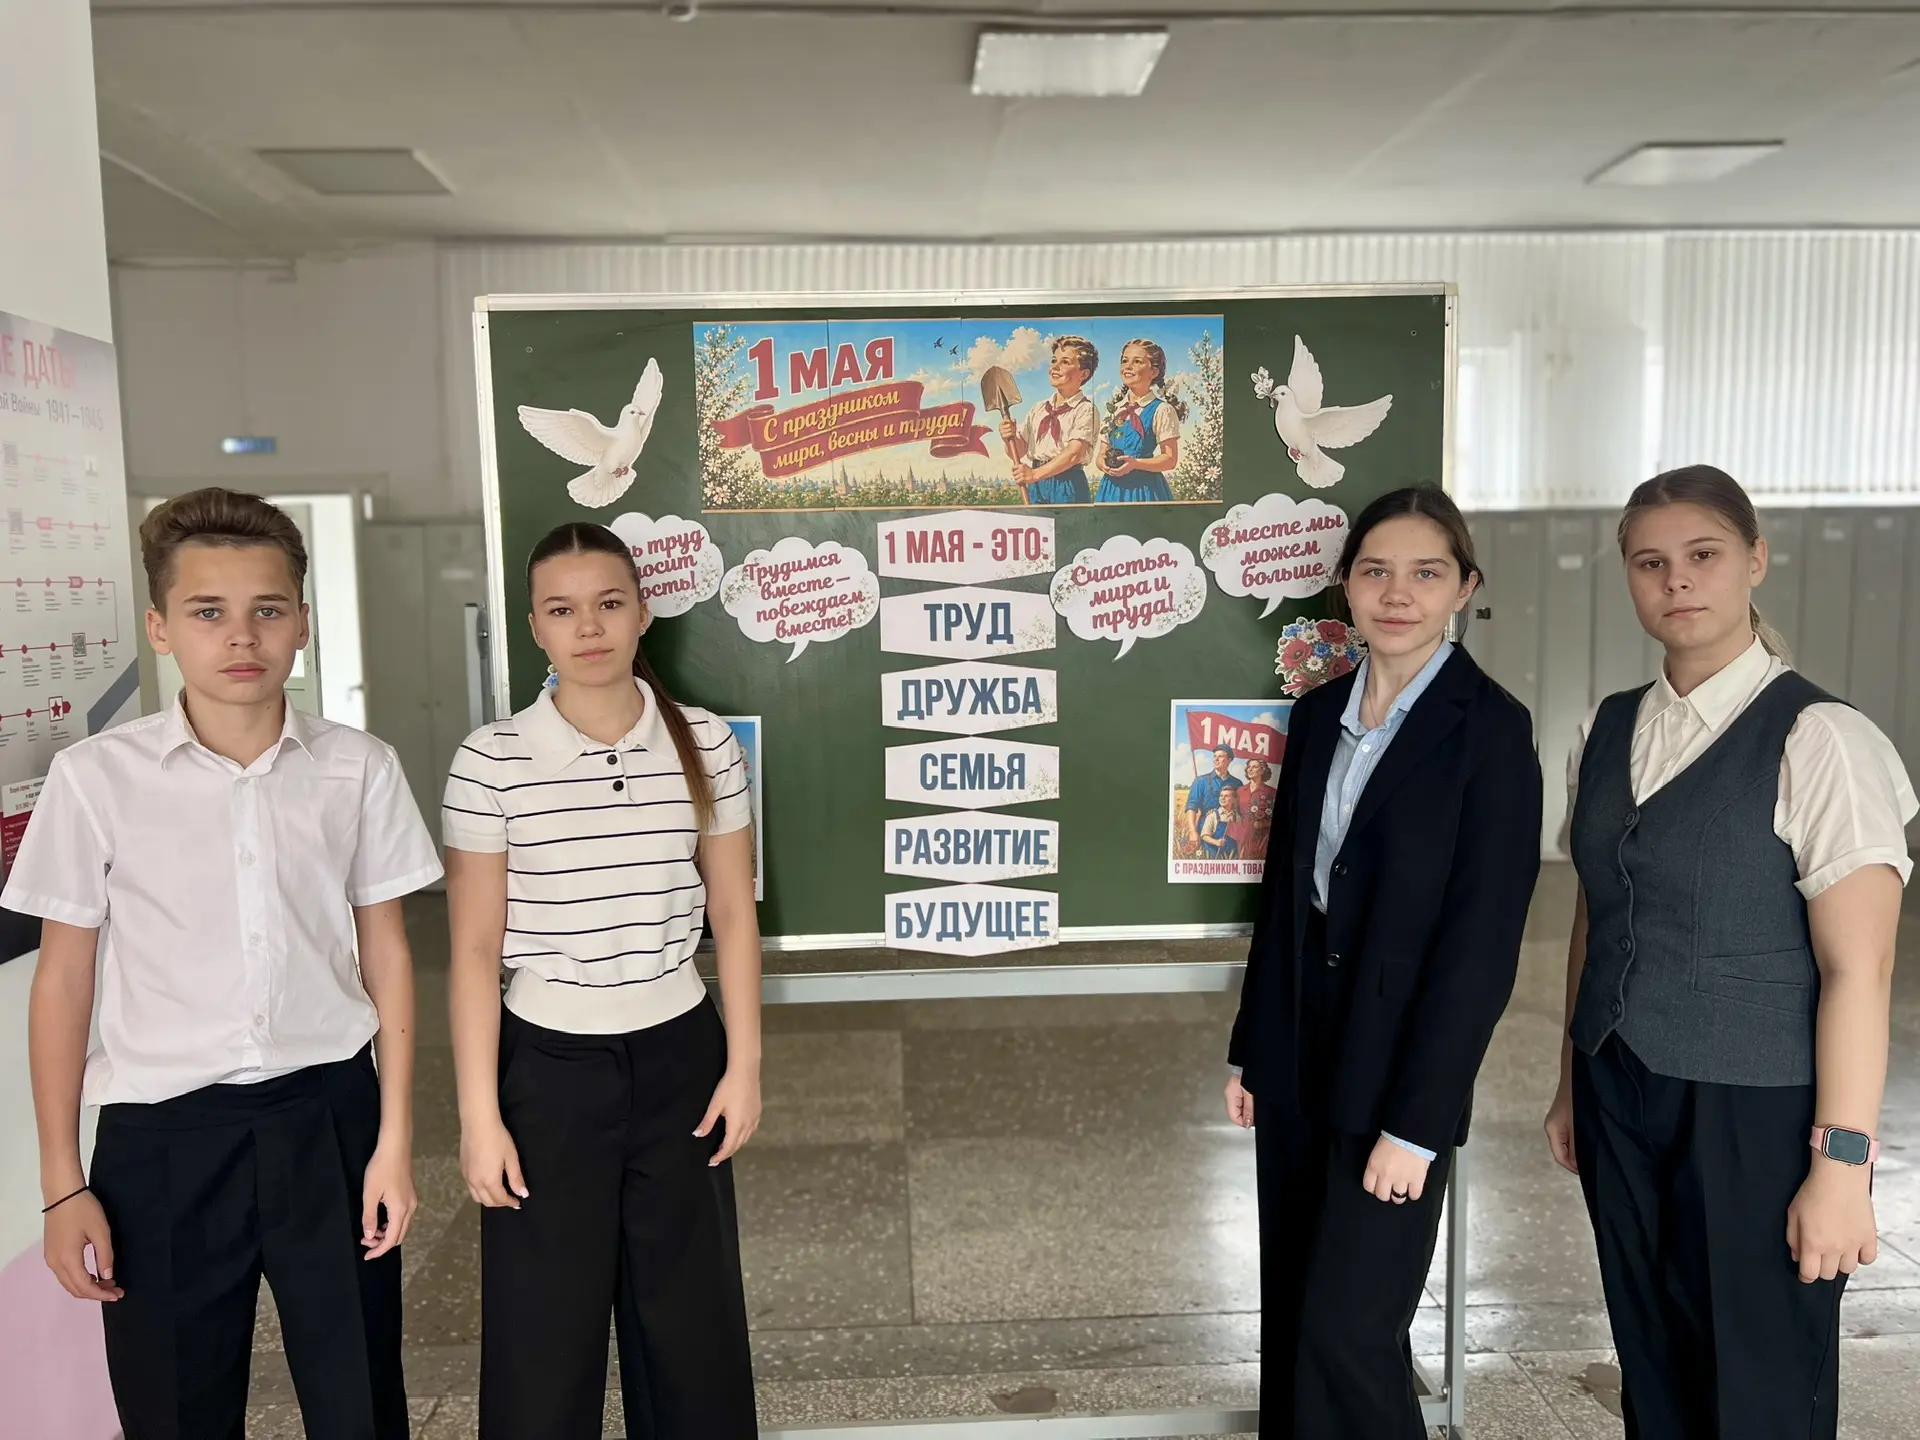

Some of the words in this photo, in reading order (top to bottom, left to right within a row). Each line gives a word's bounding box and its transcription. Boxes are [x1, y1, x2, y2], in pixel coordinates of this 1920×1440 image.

[748, 337, 780, 402] 1
[789, 336, 894, 395] МАЯ
[763, 418, 778, 443] С
[783, 390, 900, 437] праздником
[773, 442, 825, 468] мира,
[828, 431, 880, 451] весны
[883, 423, 896, 436] и
[900, 408, 968, 439] труда!
[647, 529, 705, 558] труд
[885, 531, 896, 564] 1
[906, 529, 965, 564] МАЯ
[991, 527, 1049, 561] ЭТО:
[1212, 520, 1303, 547] Вместе
[1305, 514, 1344, 532] мы
[743, 552, 841, 587] Трудимся
[1071, 552, 1178, 587] Счастья,
[1240, 540, 1321, 566] можем
[640, 570, 696, 600] ость!
[760, 576, 834, 600] вместе
[1089, 580, 1152, 608] мира
[1154, 576, 1170, 591] и
[1242, 562, 1325, 588] больше
[756, 590, 865, 623] побеждаем
[775, 608, 853, 639] вместе!
[923, 602, 1014, 645] ТРУД
[1092, 591, 1173, 633] труда!
[897, 676, 1043, 721] ДРУЖБА
[1201, 716, 1211, 744] 1
[1217, 724, 1269, 756] МАЯ
[919, 752, 1026, 791] СЕМЬЯ
[894, 828, 1050, 866] РАЗВИТИЕ
[1174, 863, 1180, 875] С
[1183, 863, 1241, 876] ПРАЗДНИКОМ,
[1243, 863, 1263, 875] ТОВА
[895, 901, 1050, 942] БУДУЩЕЕ
